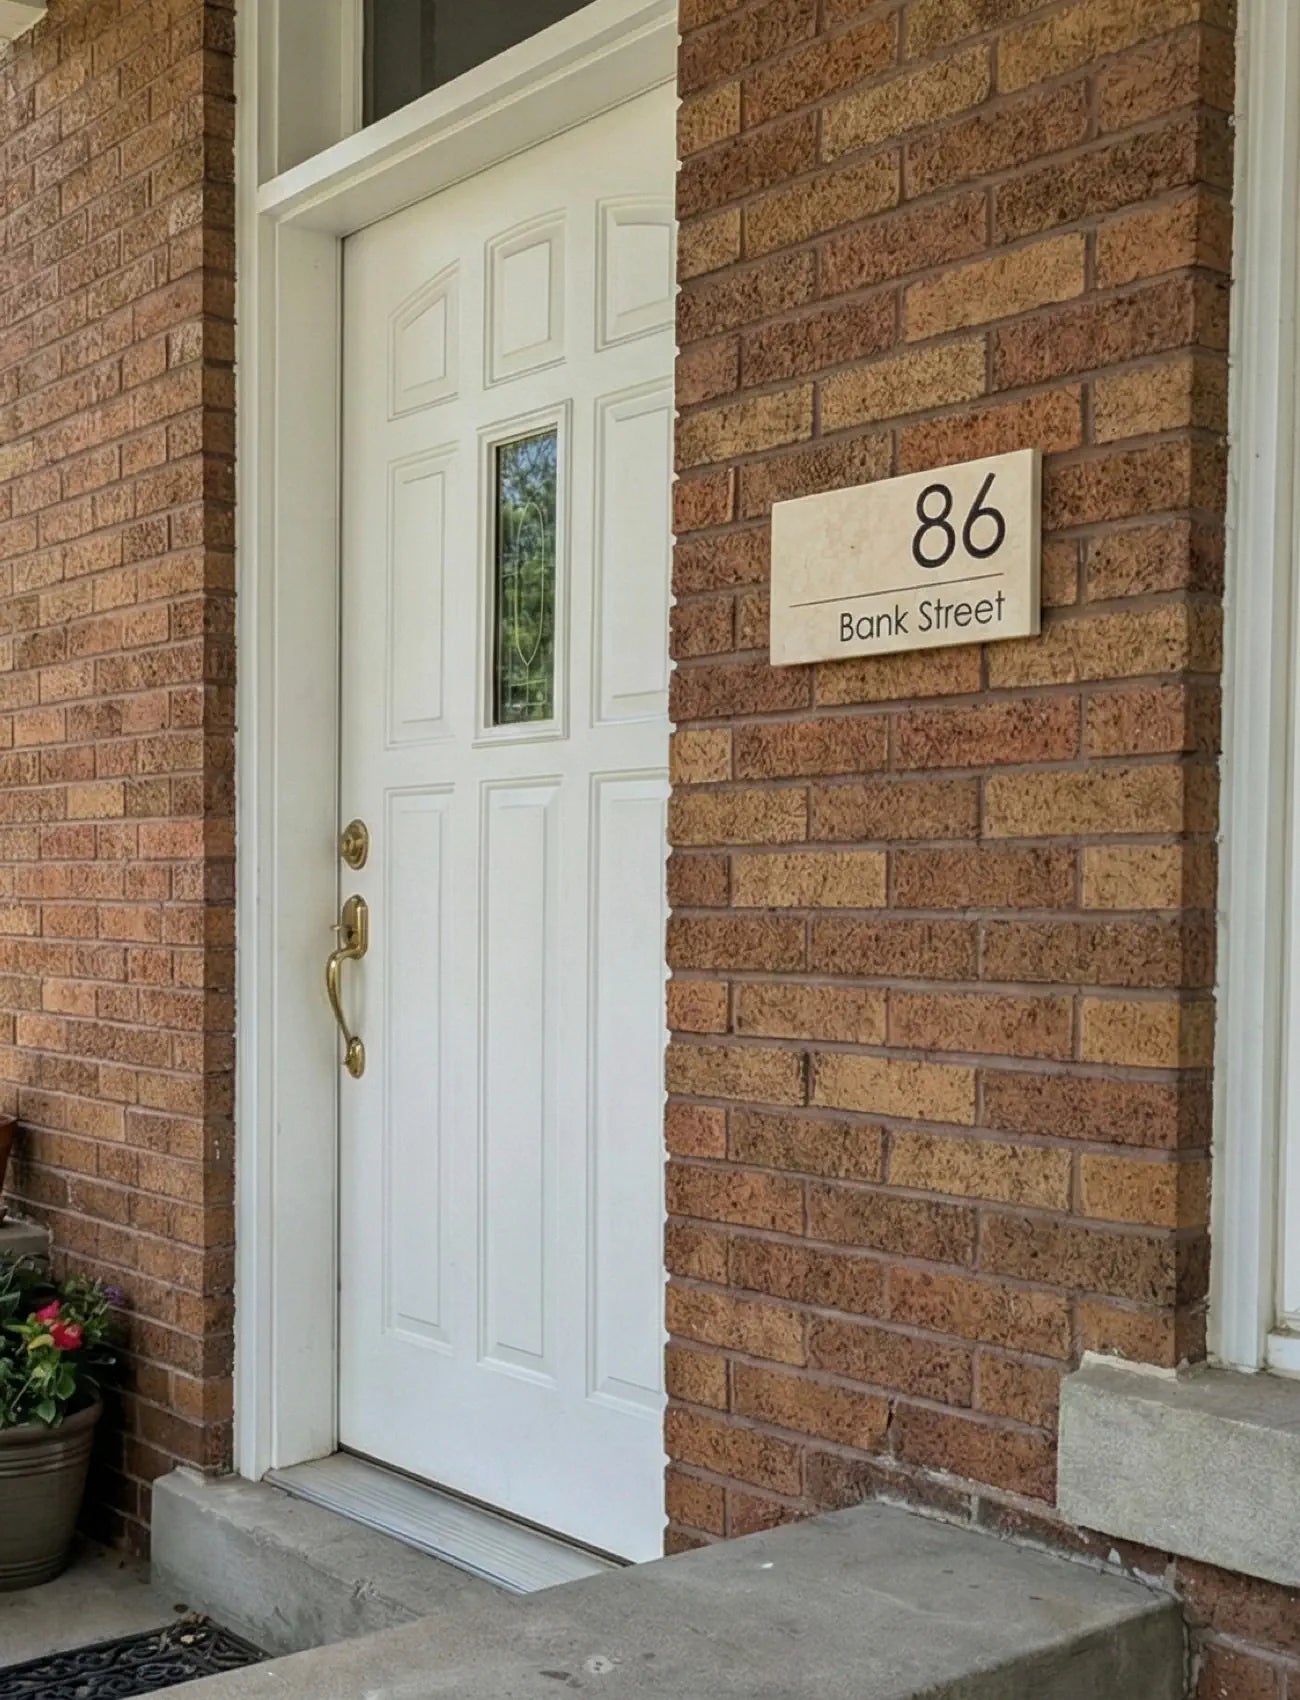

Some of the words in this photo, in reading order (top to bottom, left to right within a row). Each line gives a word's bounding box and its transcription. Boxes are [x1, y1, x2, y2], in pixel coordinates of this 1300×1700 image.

[912, 472, 1006, 569] 86
[840, 604, 909, 642] Bank
[918, 590, 1005, 632] Street
